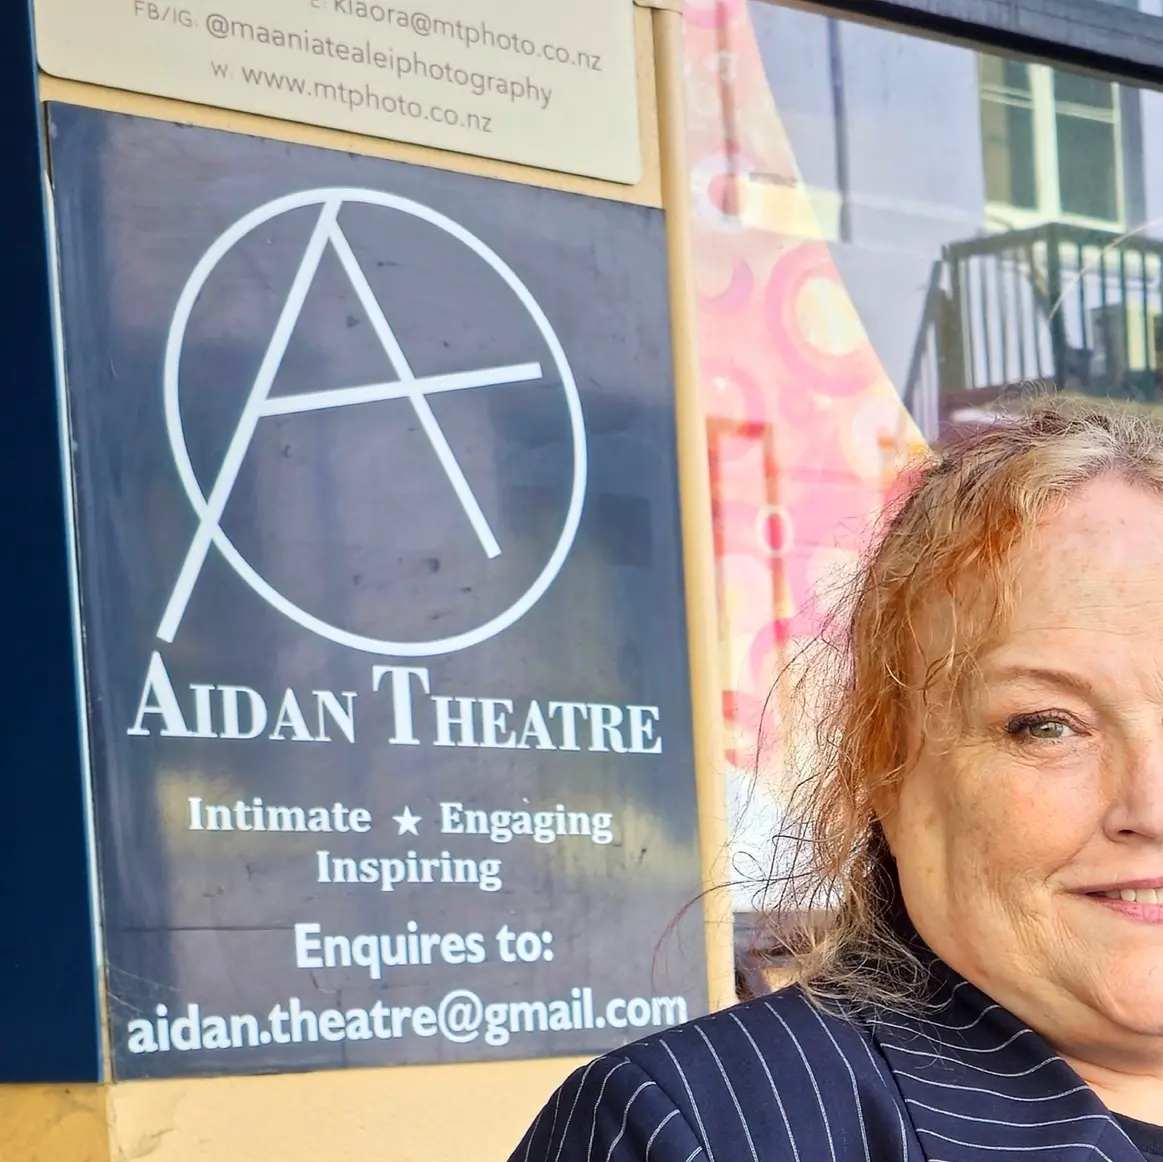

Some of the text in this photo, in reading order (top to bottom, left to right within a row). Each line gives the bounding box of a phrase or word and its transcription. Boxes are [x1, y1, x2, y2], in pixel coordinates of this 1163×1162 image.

[206, 13, 552, 110] @maaniatealeiphotography
[333, 0, 603, 72] kiaora@mtphoto.co.nz
[242, 66, 493, 134] www.mtphoto.co.nz
[127, 651, 663, 755] AIDAN THEATRE
[188, 797, 614, 844] Intimate Engaging
[316, 851, 503, 892] Inspiring
[294, 921, 555, 980] Enquires to:
[127, 988, 688, 1054] aidan.theatre@gmail.com
